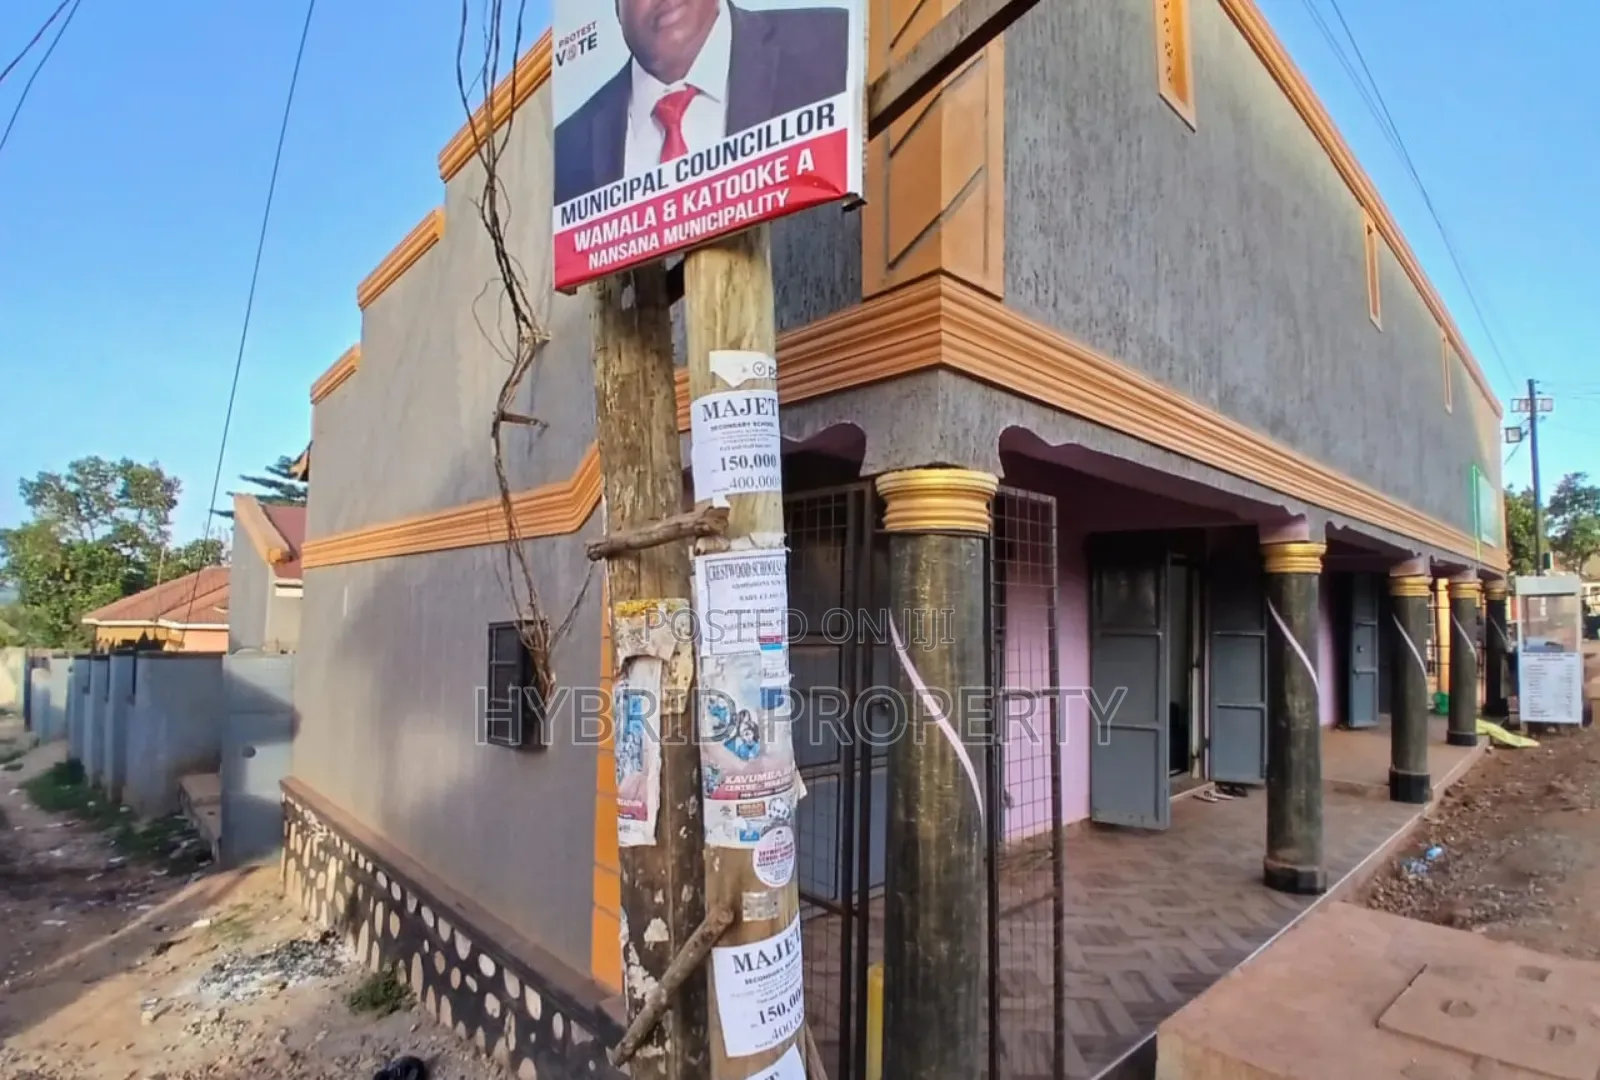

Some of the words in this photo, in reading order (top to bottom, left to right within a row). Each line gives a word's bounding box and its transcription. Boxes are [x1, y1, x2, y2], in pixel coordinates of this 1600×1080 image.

[558, 20, 597, 48] PROTEST
[560, 168, 669, 226] MUNICIPAL
[675, 102, 835, 184] COUNCILLOR
[573, 206, 657, 253] WAMALA
[663, 199, 677, 222] &
[683, 155, 790, 215] KATOOKE
[796, 148, 815, 175] A
[588, 235, 660, 271] NANSANA
[663, 188, 791, 245] MUNICIPALITY
[721, 454, 776, 472] 150,000
